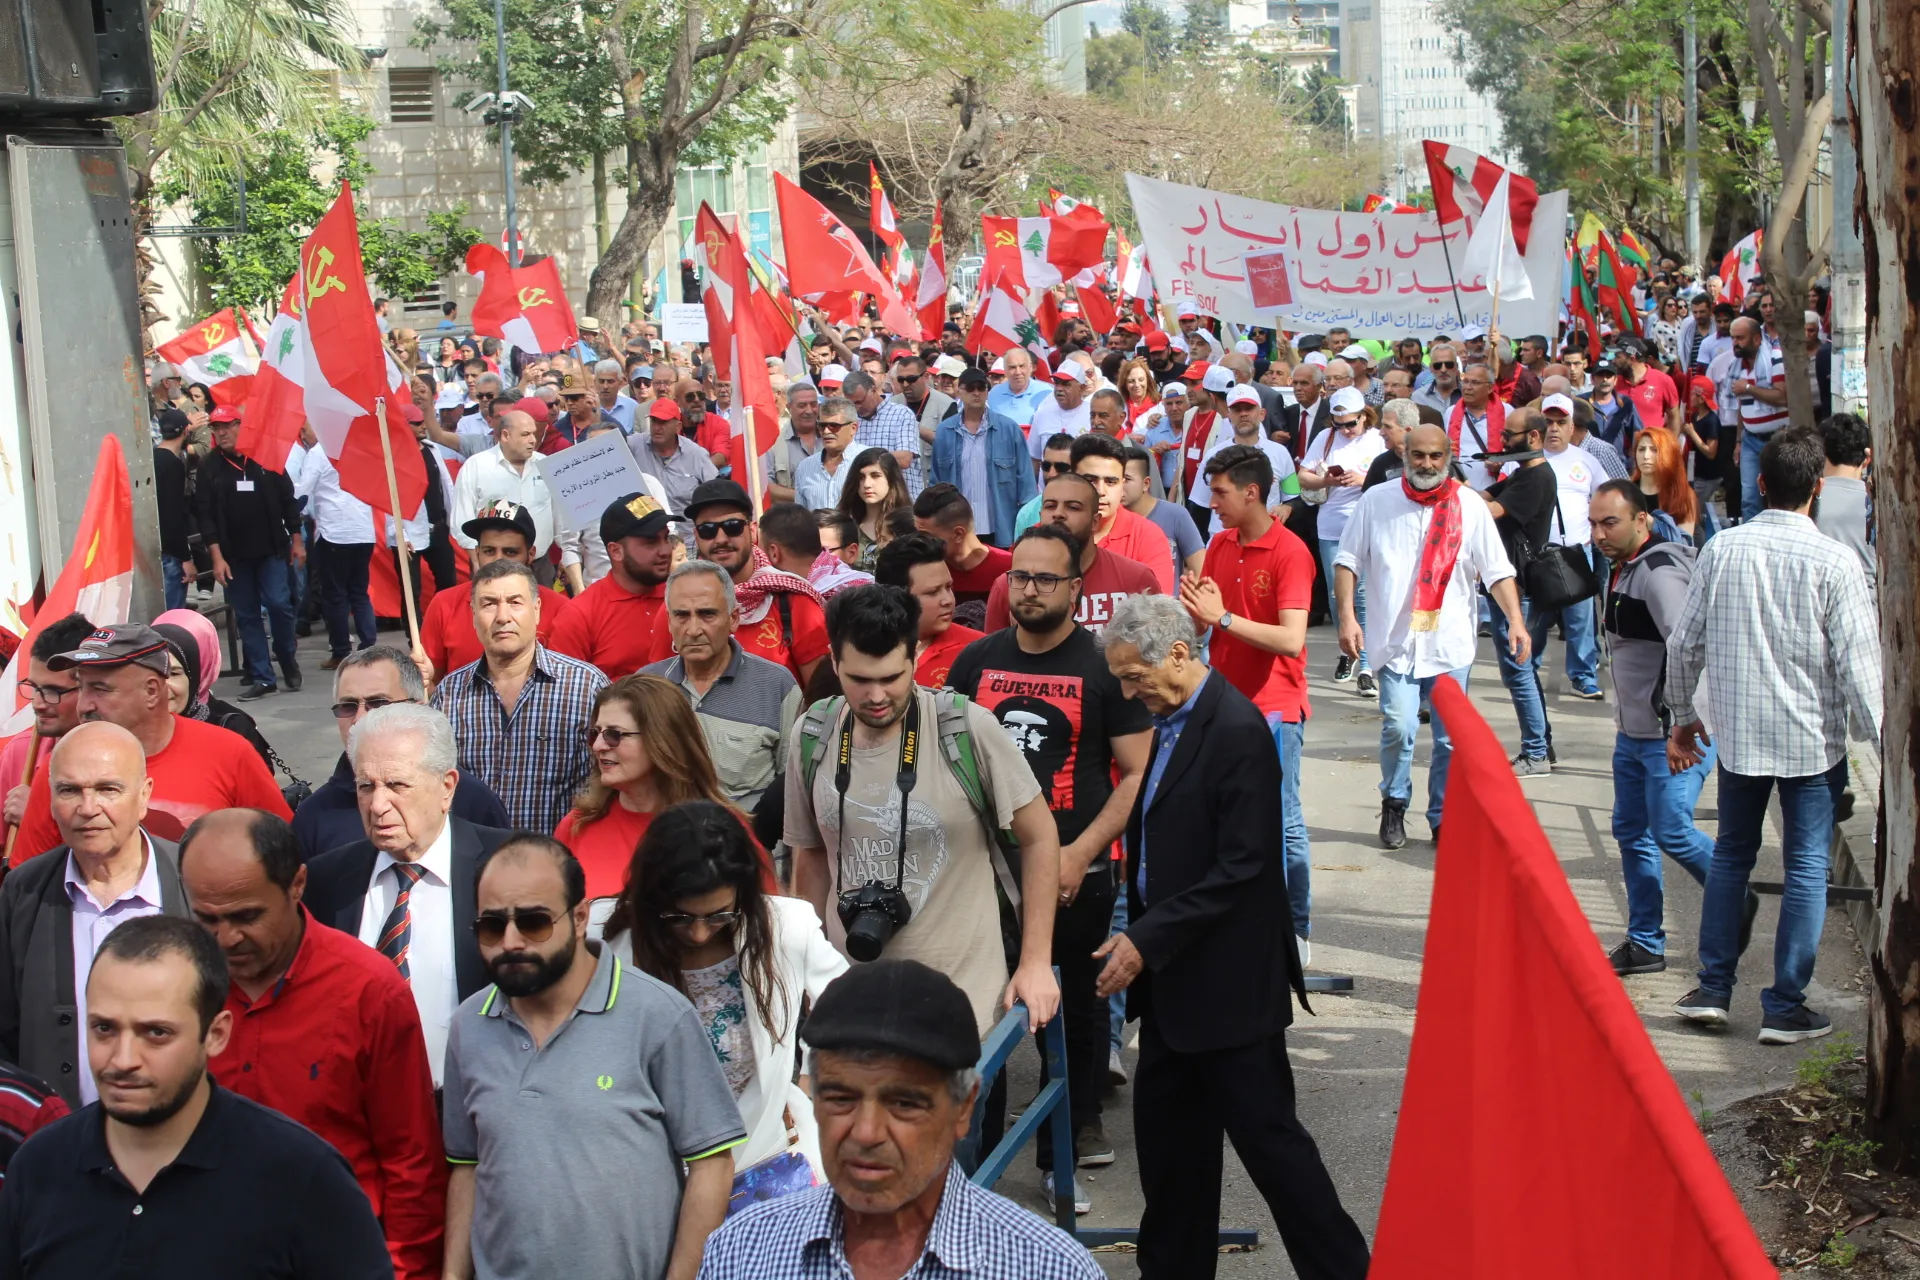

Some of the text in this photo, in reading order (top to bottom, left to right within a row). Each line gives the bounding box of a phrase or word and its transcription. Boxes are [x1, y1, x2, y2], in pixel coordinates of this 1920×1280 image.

[1317, 215, 1386, 259] أول
[1397, 269, 1488, 304] عيد
[1435, 311, 1467, 335] اوطني
[990, 679, 1078, 699] GUEVARA
[841, 732, 849, 764] Nikon
[903, 731, 916, 764] Nikon
[850, 837, 894, 862] MAD
[841, 854, 919, 886] MARLIN
